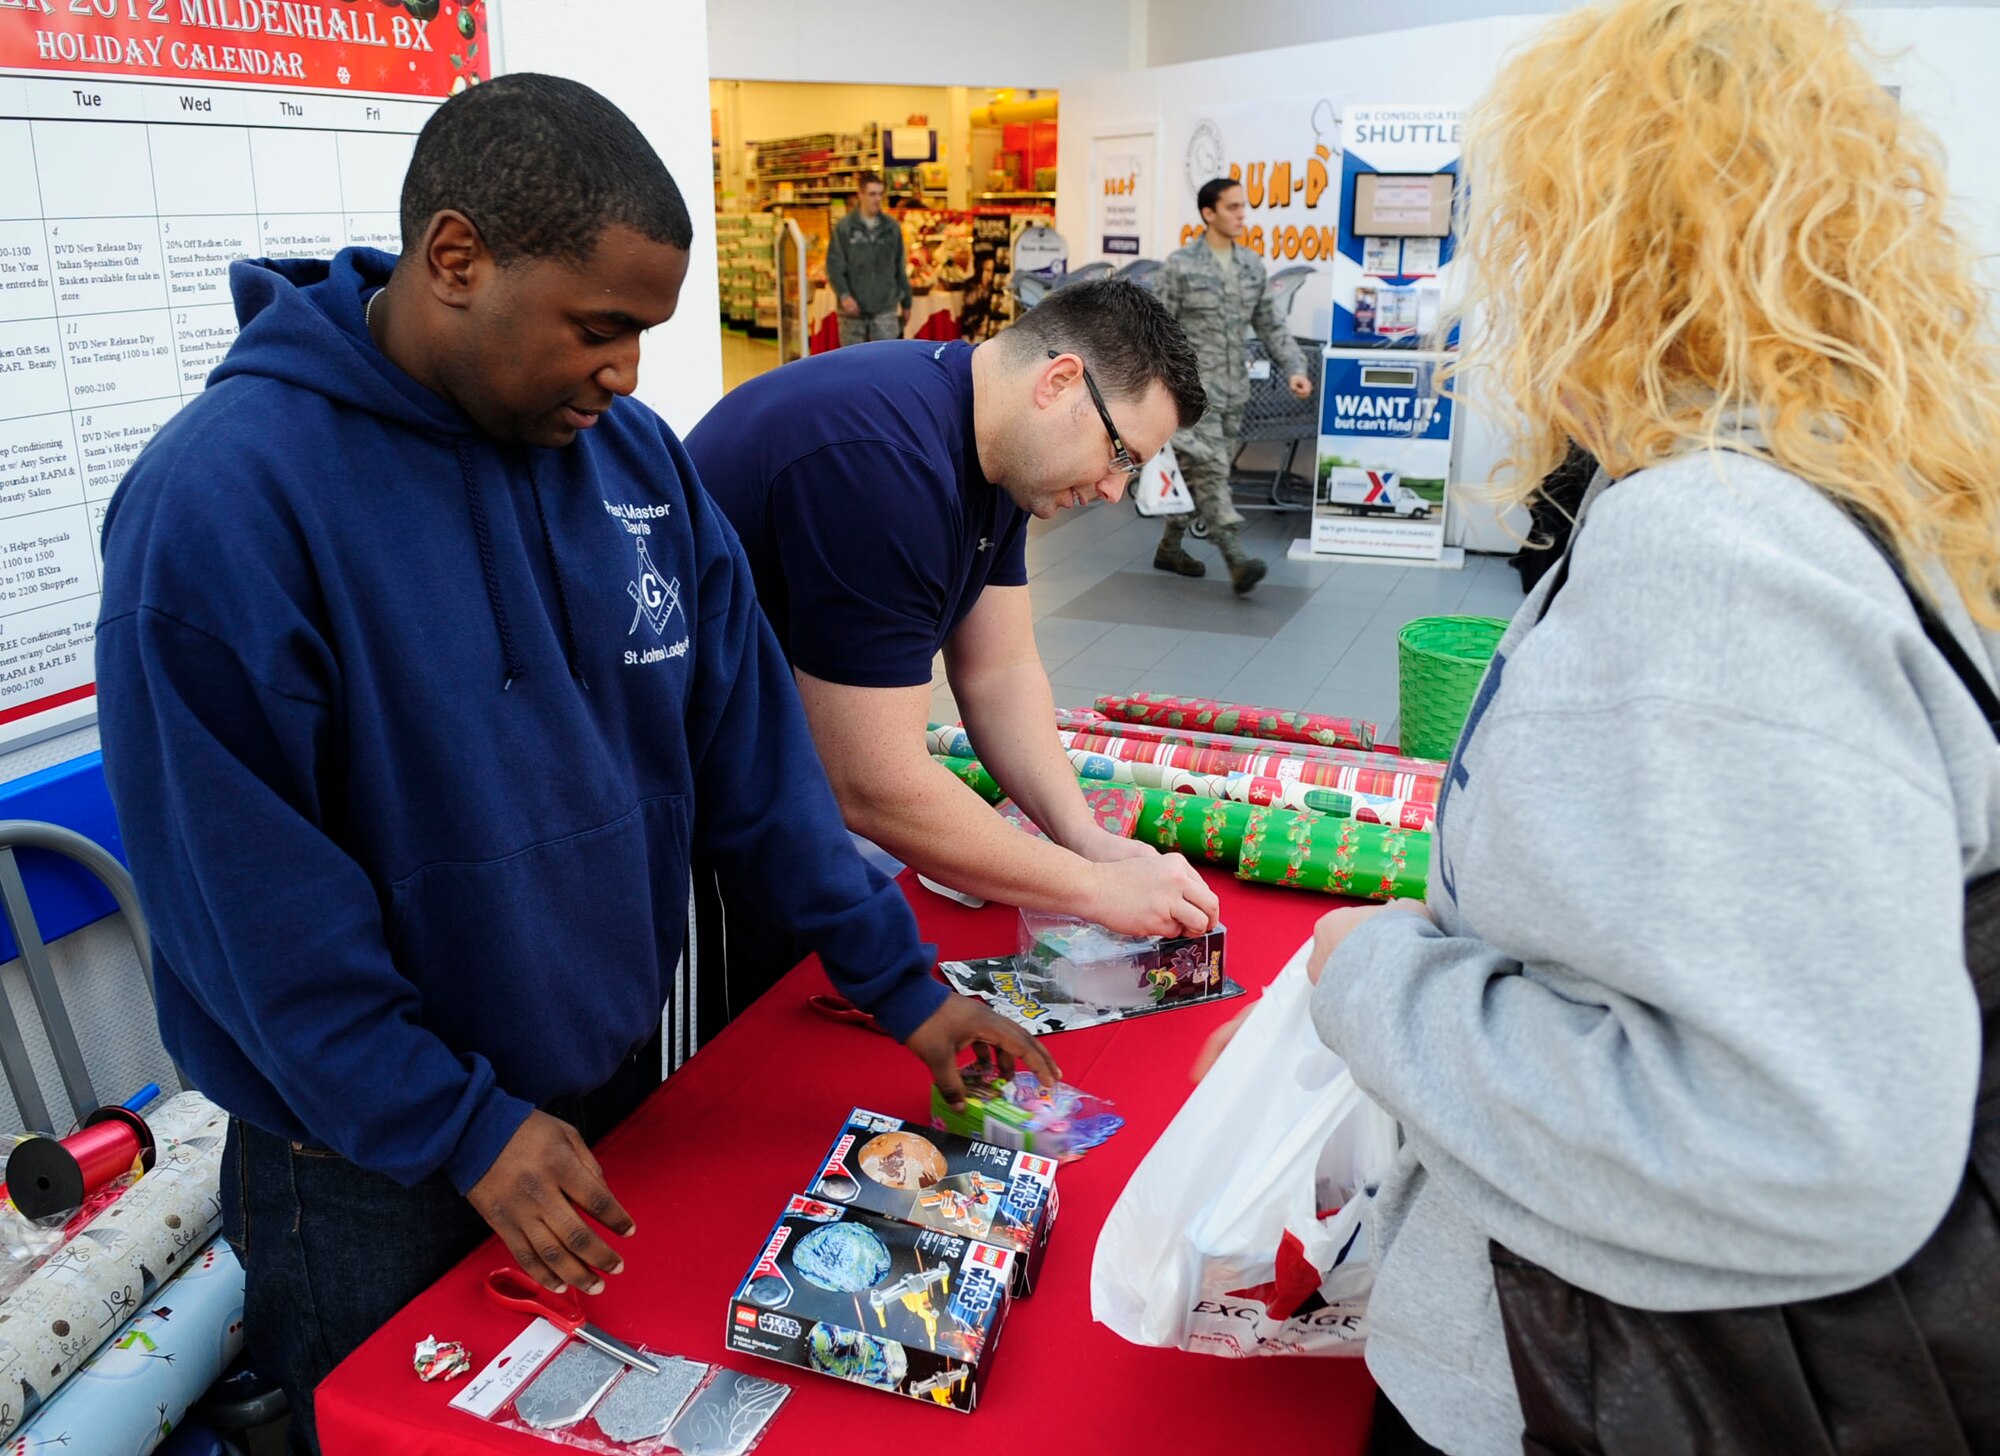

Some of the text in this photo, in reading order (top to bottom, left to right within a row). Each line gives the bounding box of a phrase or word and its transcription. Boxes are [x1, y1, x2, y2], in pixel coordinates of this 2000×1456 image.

[180, 0, 388, 47] MILDENHALL
[391, 15, 434, 52] BX
[35, 30, 307, 79] HOLIDAY CALENDAR
[73, 90, 102, 107] Tue
[179, 96, 212, 112] Wed
[279, 101, 303, 117] Thu
[366, 107, 381, 121] Fri
[1355, 124, 1462, 143] SHUTTLE
[52, 227, 59, 236] 4
[164, 222, 170, 233] 5
[263, 221, 269, 230] 6
[55, 242, 144, 255] DVD New Release Day
[183, 239, 197, 249] Off
[223, 238, 243, 248] Color
[1271, 224, 1336, 261] SOON
[57, 257, 140, 271] Italian Specialties Gift
[168, 253, 224, 264] Extend Products
[1, 262, 39, 273] Use Your
[170, 269, 195, 279] Service
[196, 268, 203, 277] at
[6, 278, 49, 289] entered for
[59, 272, 160, 286] Baskets available for sale in
[172, 282, 217, 294] Beauty Salon
[61, 292, 80, 301] store
[177, 313, 187, 324] 12
[67, 323, 77, 334] 11
[16, 345, 50, 356] Gift Sets
[68, 335, 155, 351] DVD New Release Day
[71, 346, 169, 365] Taste Testing 1100 to 1400
[28, 360, 57, 370] Beauty
[75, 382, 116, 395] 0900-2100
[1335, 394, 1410, 418] WANT
[81, 415, 92, 427] 18
[1334, 415, 1355, 430] but
[1356, 418, 1386, 431] can't
[1387, 418, 1413, 432] find
[82, 426, 151, 443] DVD New Release
[11, 441, 63, 454] Conditioning
[113, 442, 138, 453] Helper
[20, 455, 67, 469] Any Service
[87, 463, 106, 473] from
[107, 458, 126, 469] 1100
[0, 475, 29, 490] pounds
[40, 468, 67, 481] RAFM
[68, 467, 76, 476] &
[27, 488, 52, 498] Salon
[94, 506, 106, 518] 25
[622, 503, 670, 519] Master
[621, 519, 651, 535] Davis
[9, 532, 70, 552] Helper Specials
[3, 556, 23, 569] 1100
[35, 550, 55, 562] 1500
[16, 570, 35, 582] 1700
[18, 584, 38, 597] 2200
[40, 577, 79, 591] Shoppette
[641, 573, 662, 608] G
[21, 626, 71, 646] Conditioning
[45, 643, 66, 654] Color
[68, 634, 95, 646] Service
[624, 650, 638, 664] St
[640, 647, 665, 664] Johns
[0, 667, 26, 682] RAFM
[29, 664, 36, 674] &
[39, 657, 63, 671] RAFL
[1, 676, 44, 696] 0900-1700
[831, 1134, 855, 1162] SERIES
[994, 1148, 1012, 1166] 6-12
[1009, 1173, 1042, 1209] STAR WARS
[763, 1227, 791, 1264] SERIES
[944, 1238, 965, 1258] 6-12
[959, 1267, 996, 1310] STAR WARS
[760, 1314, 798, 1328] STAR
[760, 1322, 800, 1336] WARS
